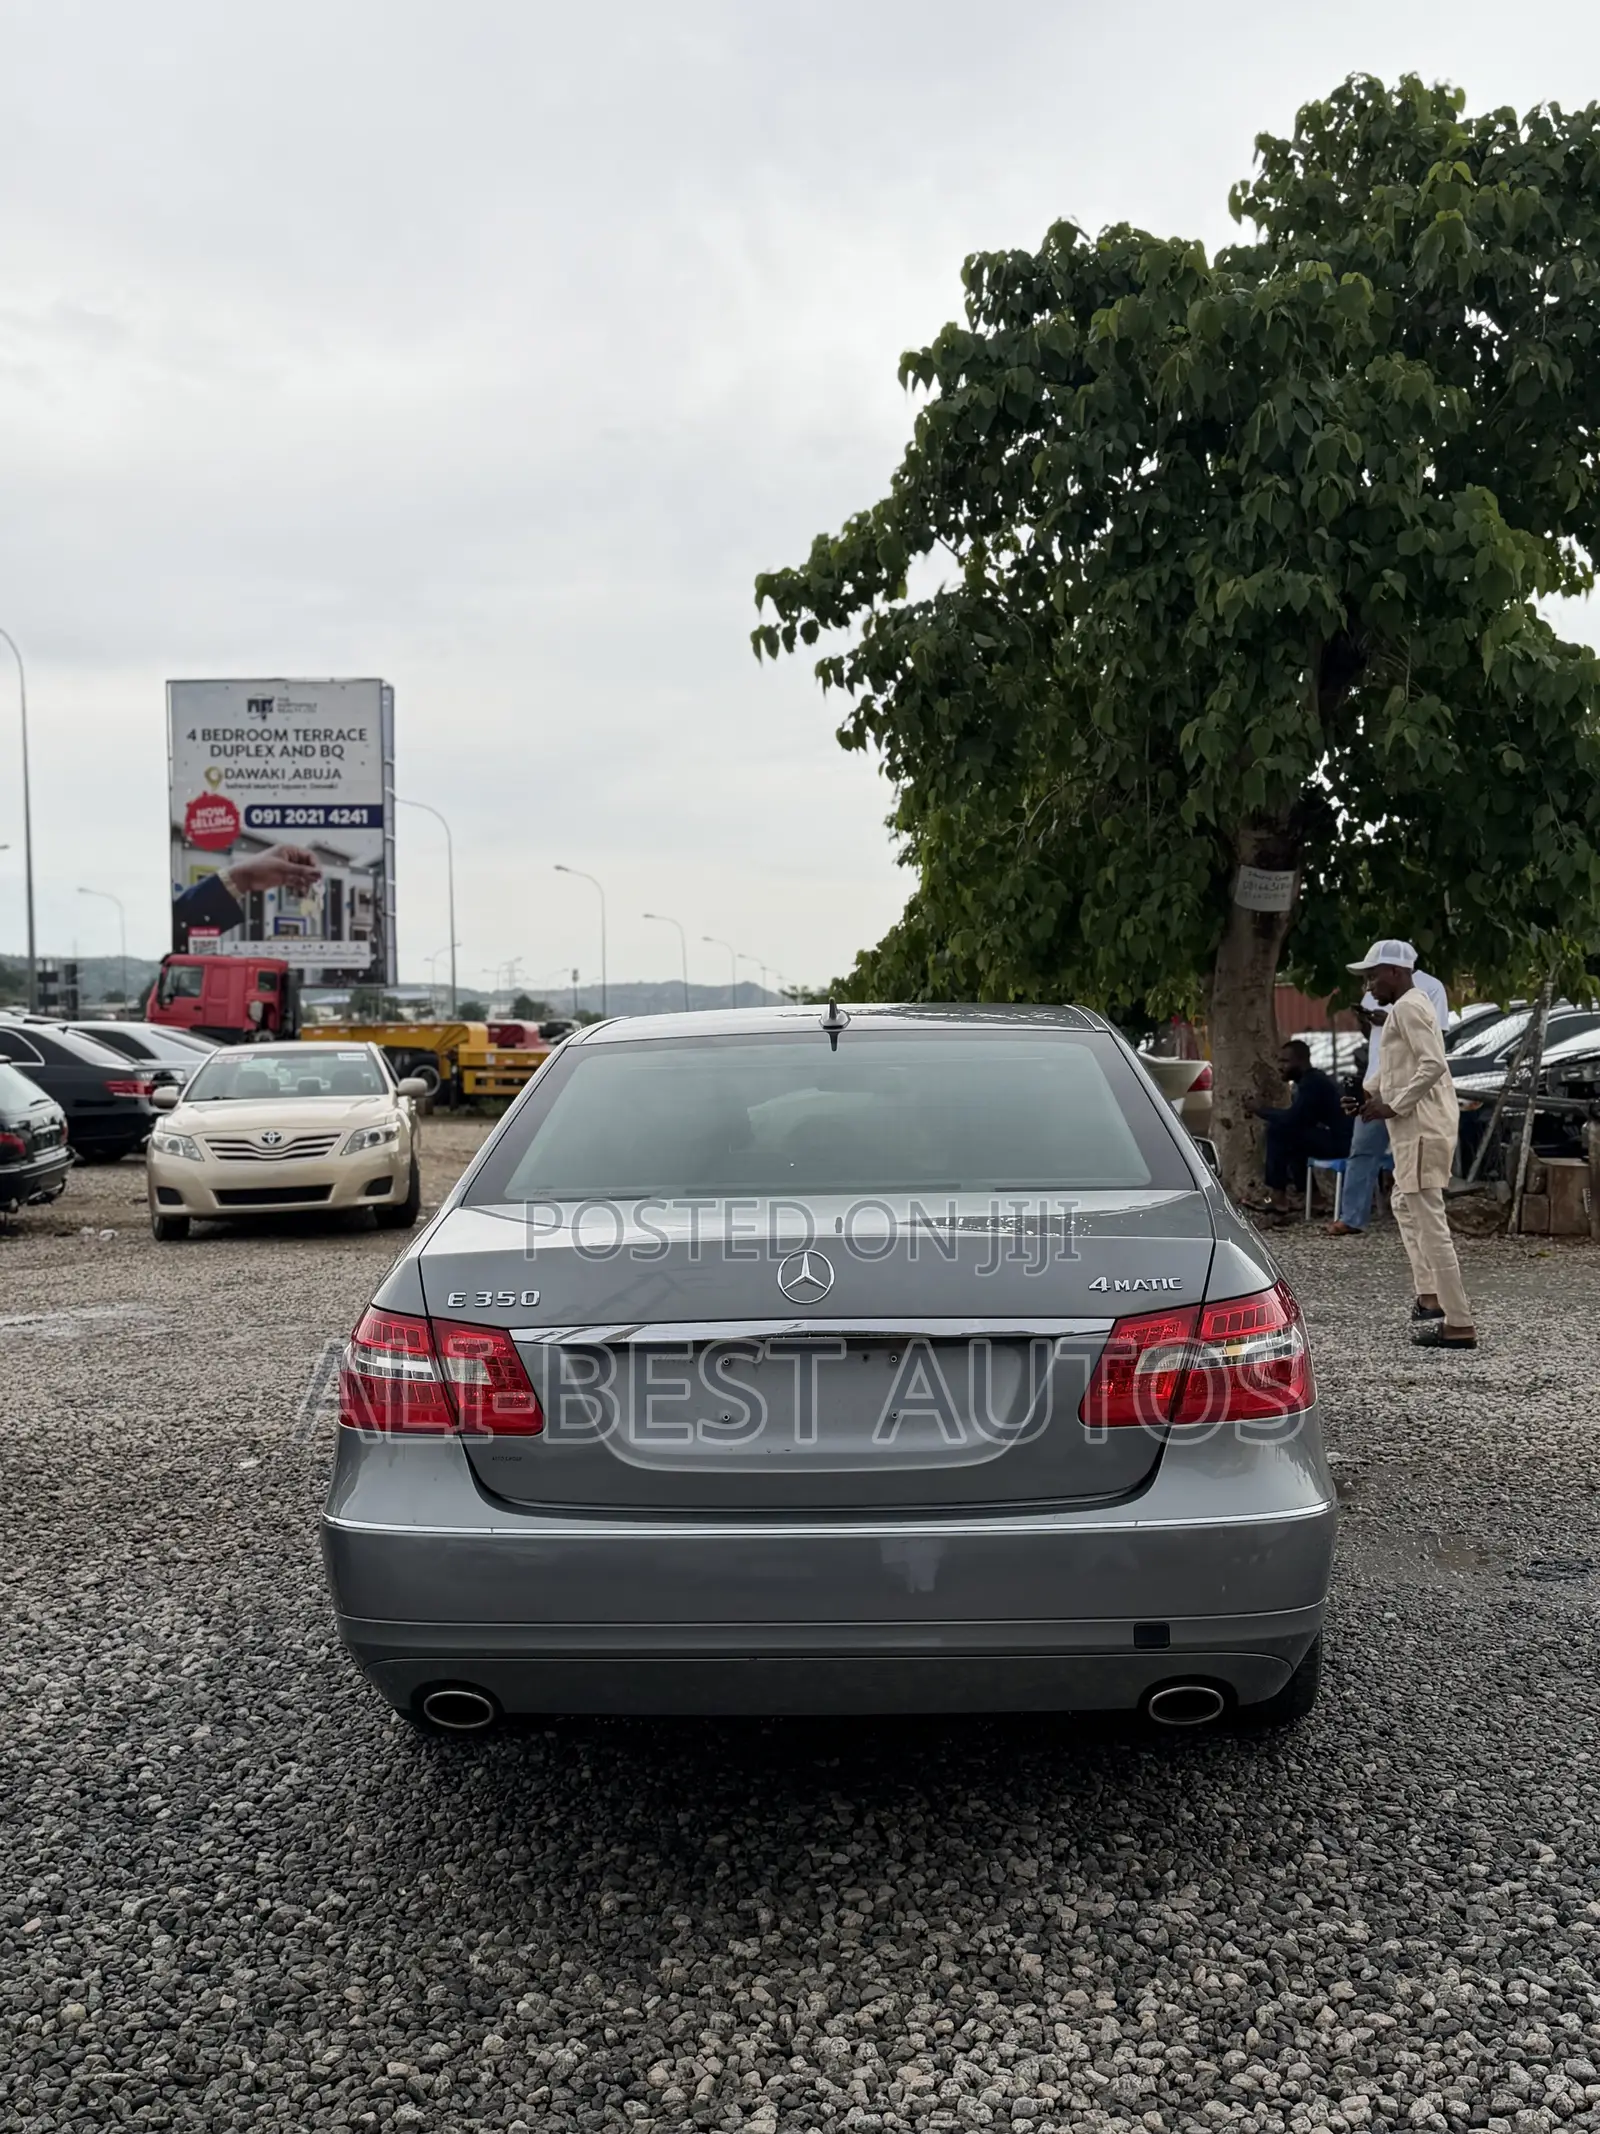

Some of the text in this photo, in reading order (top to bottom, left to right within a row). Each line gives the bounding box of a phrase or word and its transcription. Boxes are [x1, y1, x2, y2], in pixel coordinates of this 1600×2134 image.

[186, 728, 367, 742] 4 BEDROOM TERRACE
[210, 744, 345, 760] DUPLEX AND BQ
[224, 768, 285, 780] DAWAKI
[196, 806, 226, 818] NOW
[251, 809, 368, 825] 091 2021 4241
[190, 815, 236, 829] SELLING
[447, 1290, 541, 1307] E 350
